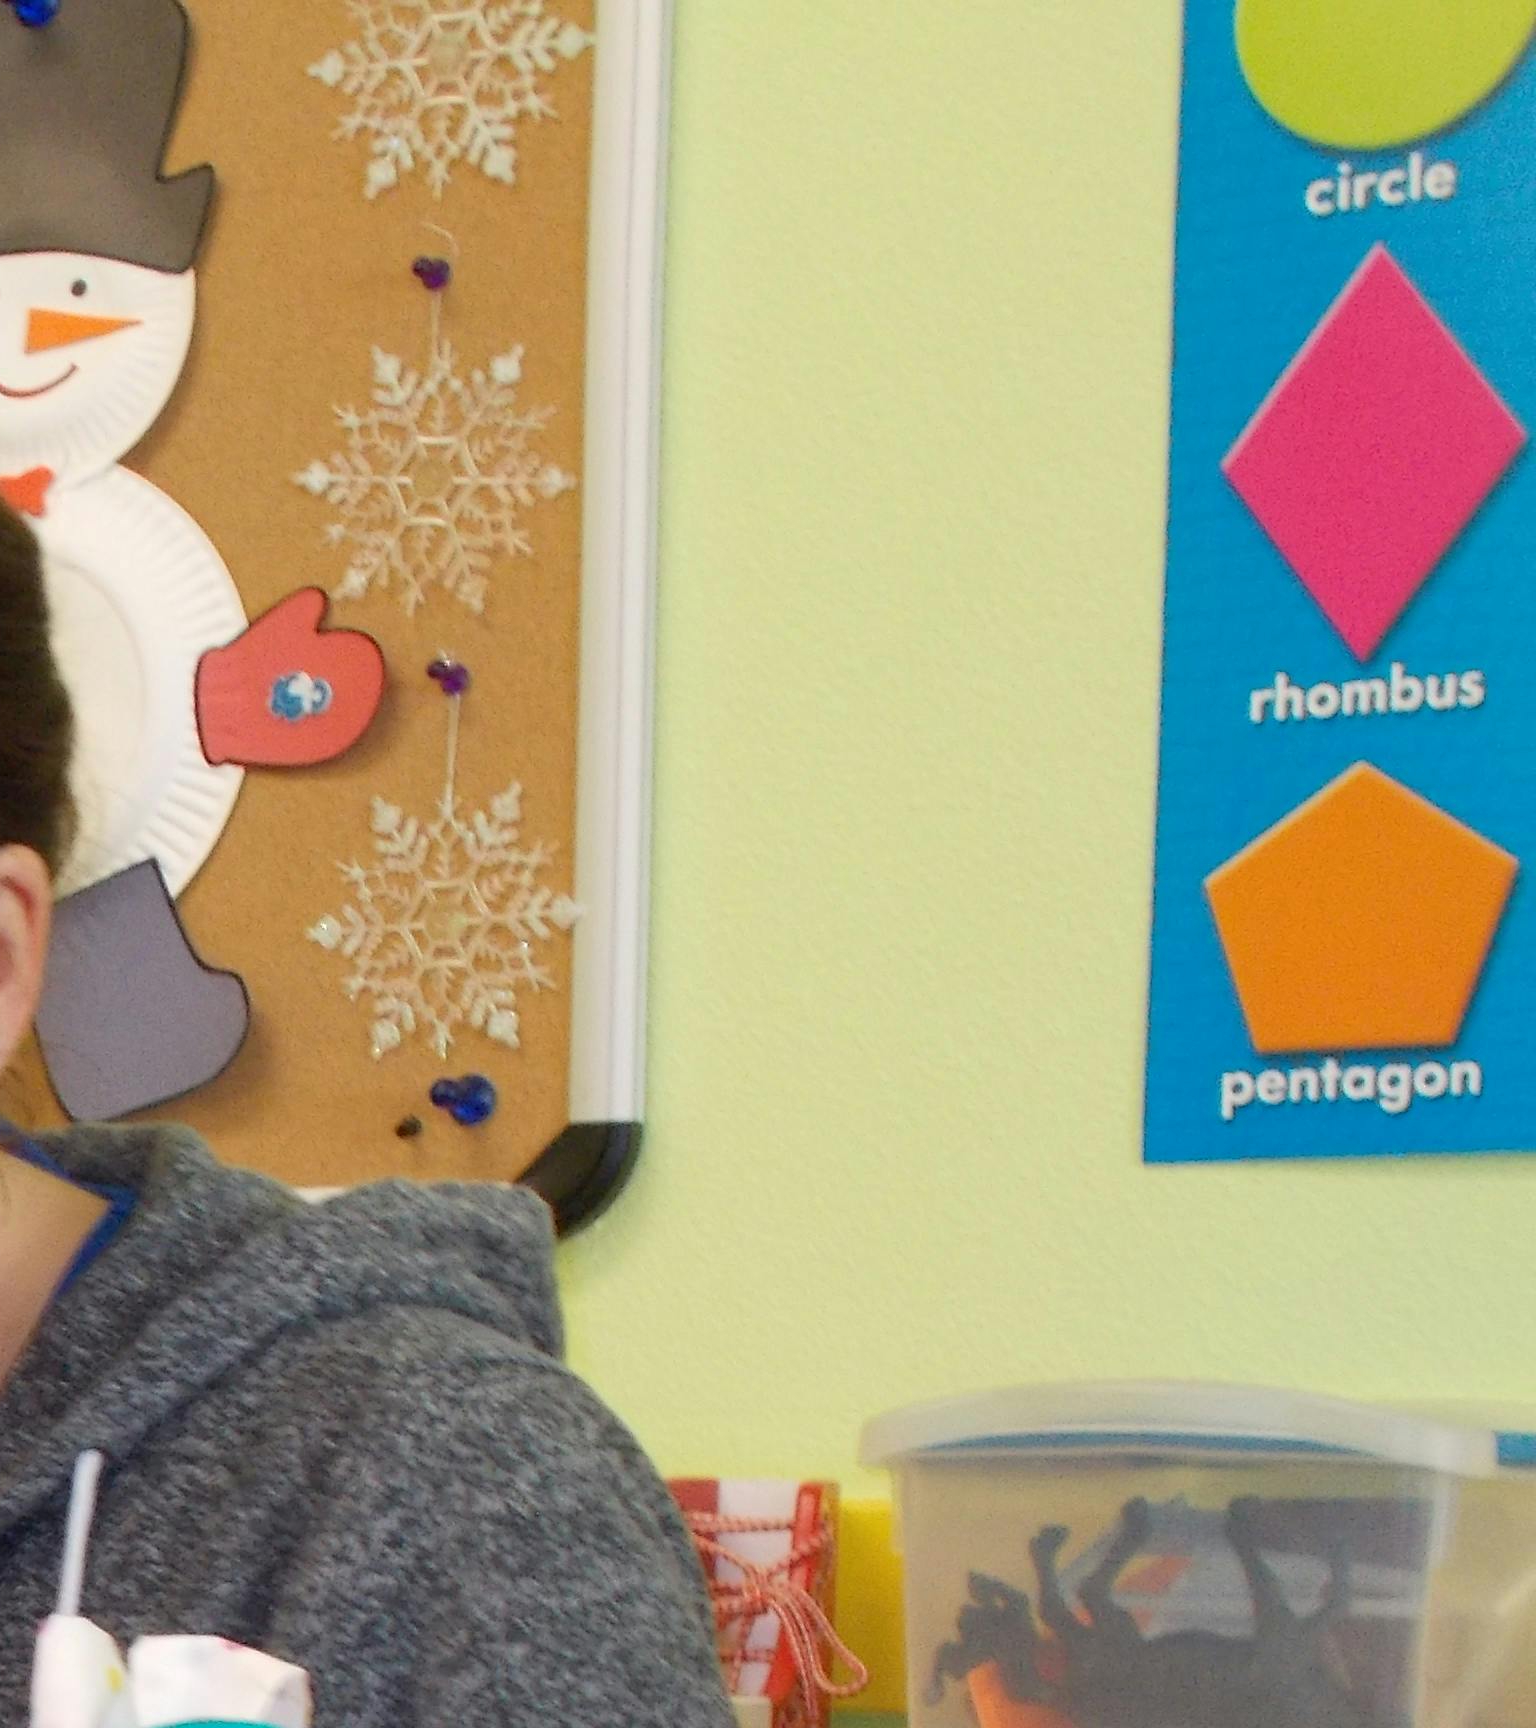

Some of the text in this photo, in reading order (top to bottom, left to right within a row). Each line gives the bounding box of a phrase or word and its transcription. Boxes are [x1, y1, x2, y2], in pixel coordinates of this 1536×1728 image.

[1305, 151, 1458, 217] circle
[1249, 661, 1485, 724] rhombus
[1221, 1056, 1482, 1121] pentagon
